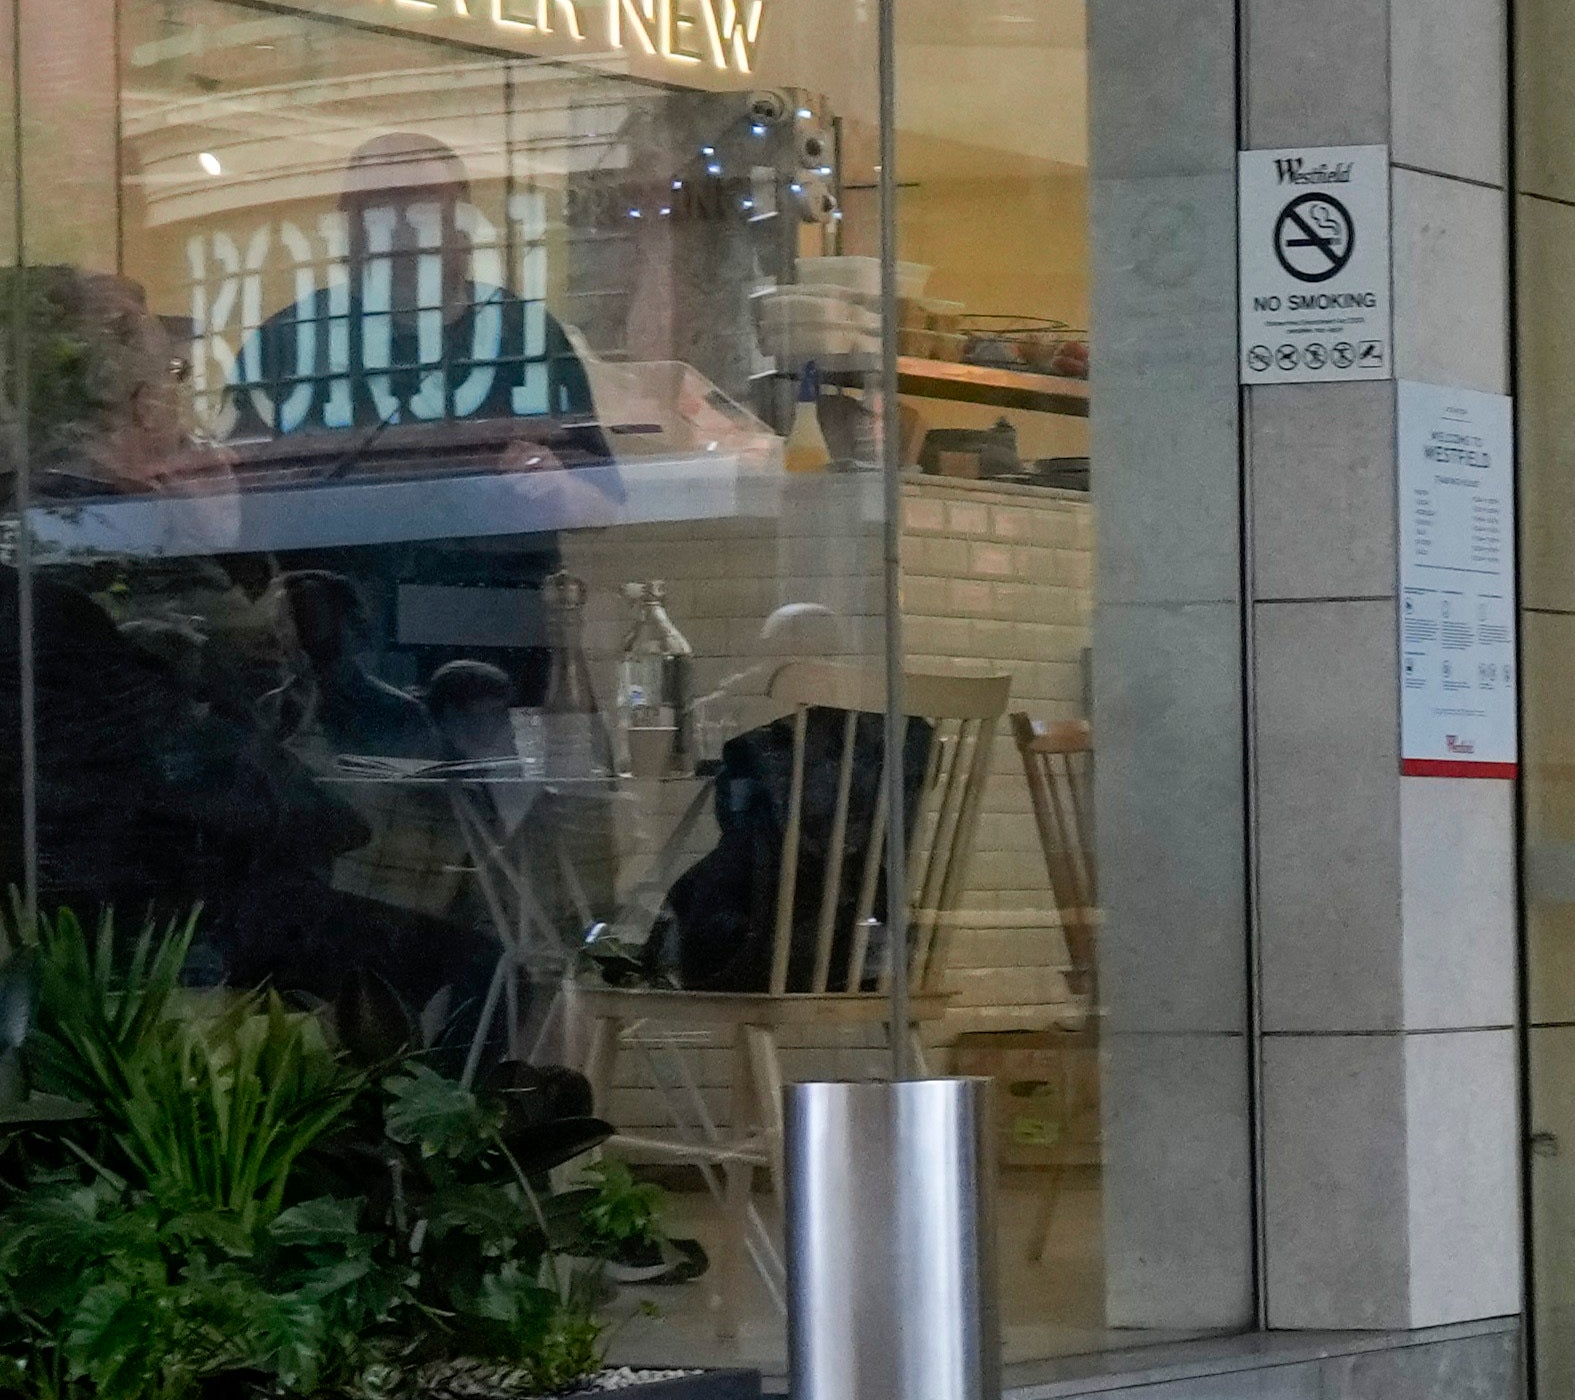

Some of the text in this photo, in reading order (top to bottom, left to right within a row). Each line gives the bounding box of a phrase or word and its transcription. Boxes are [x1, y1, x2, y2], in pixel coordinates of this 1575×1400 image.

[1253, 292, 1377, 312] NO SMOKING
[1424, 447, 1492, 469] WESTFIELD
